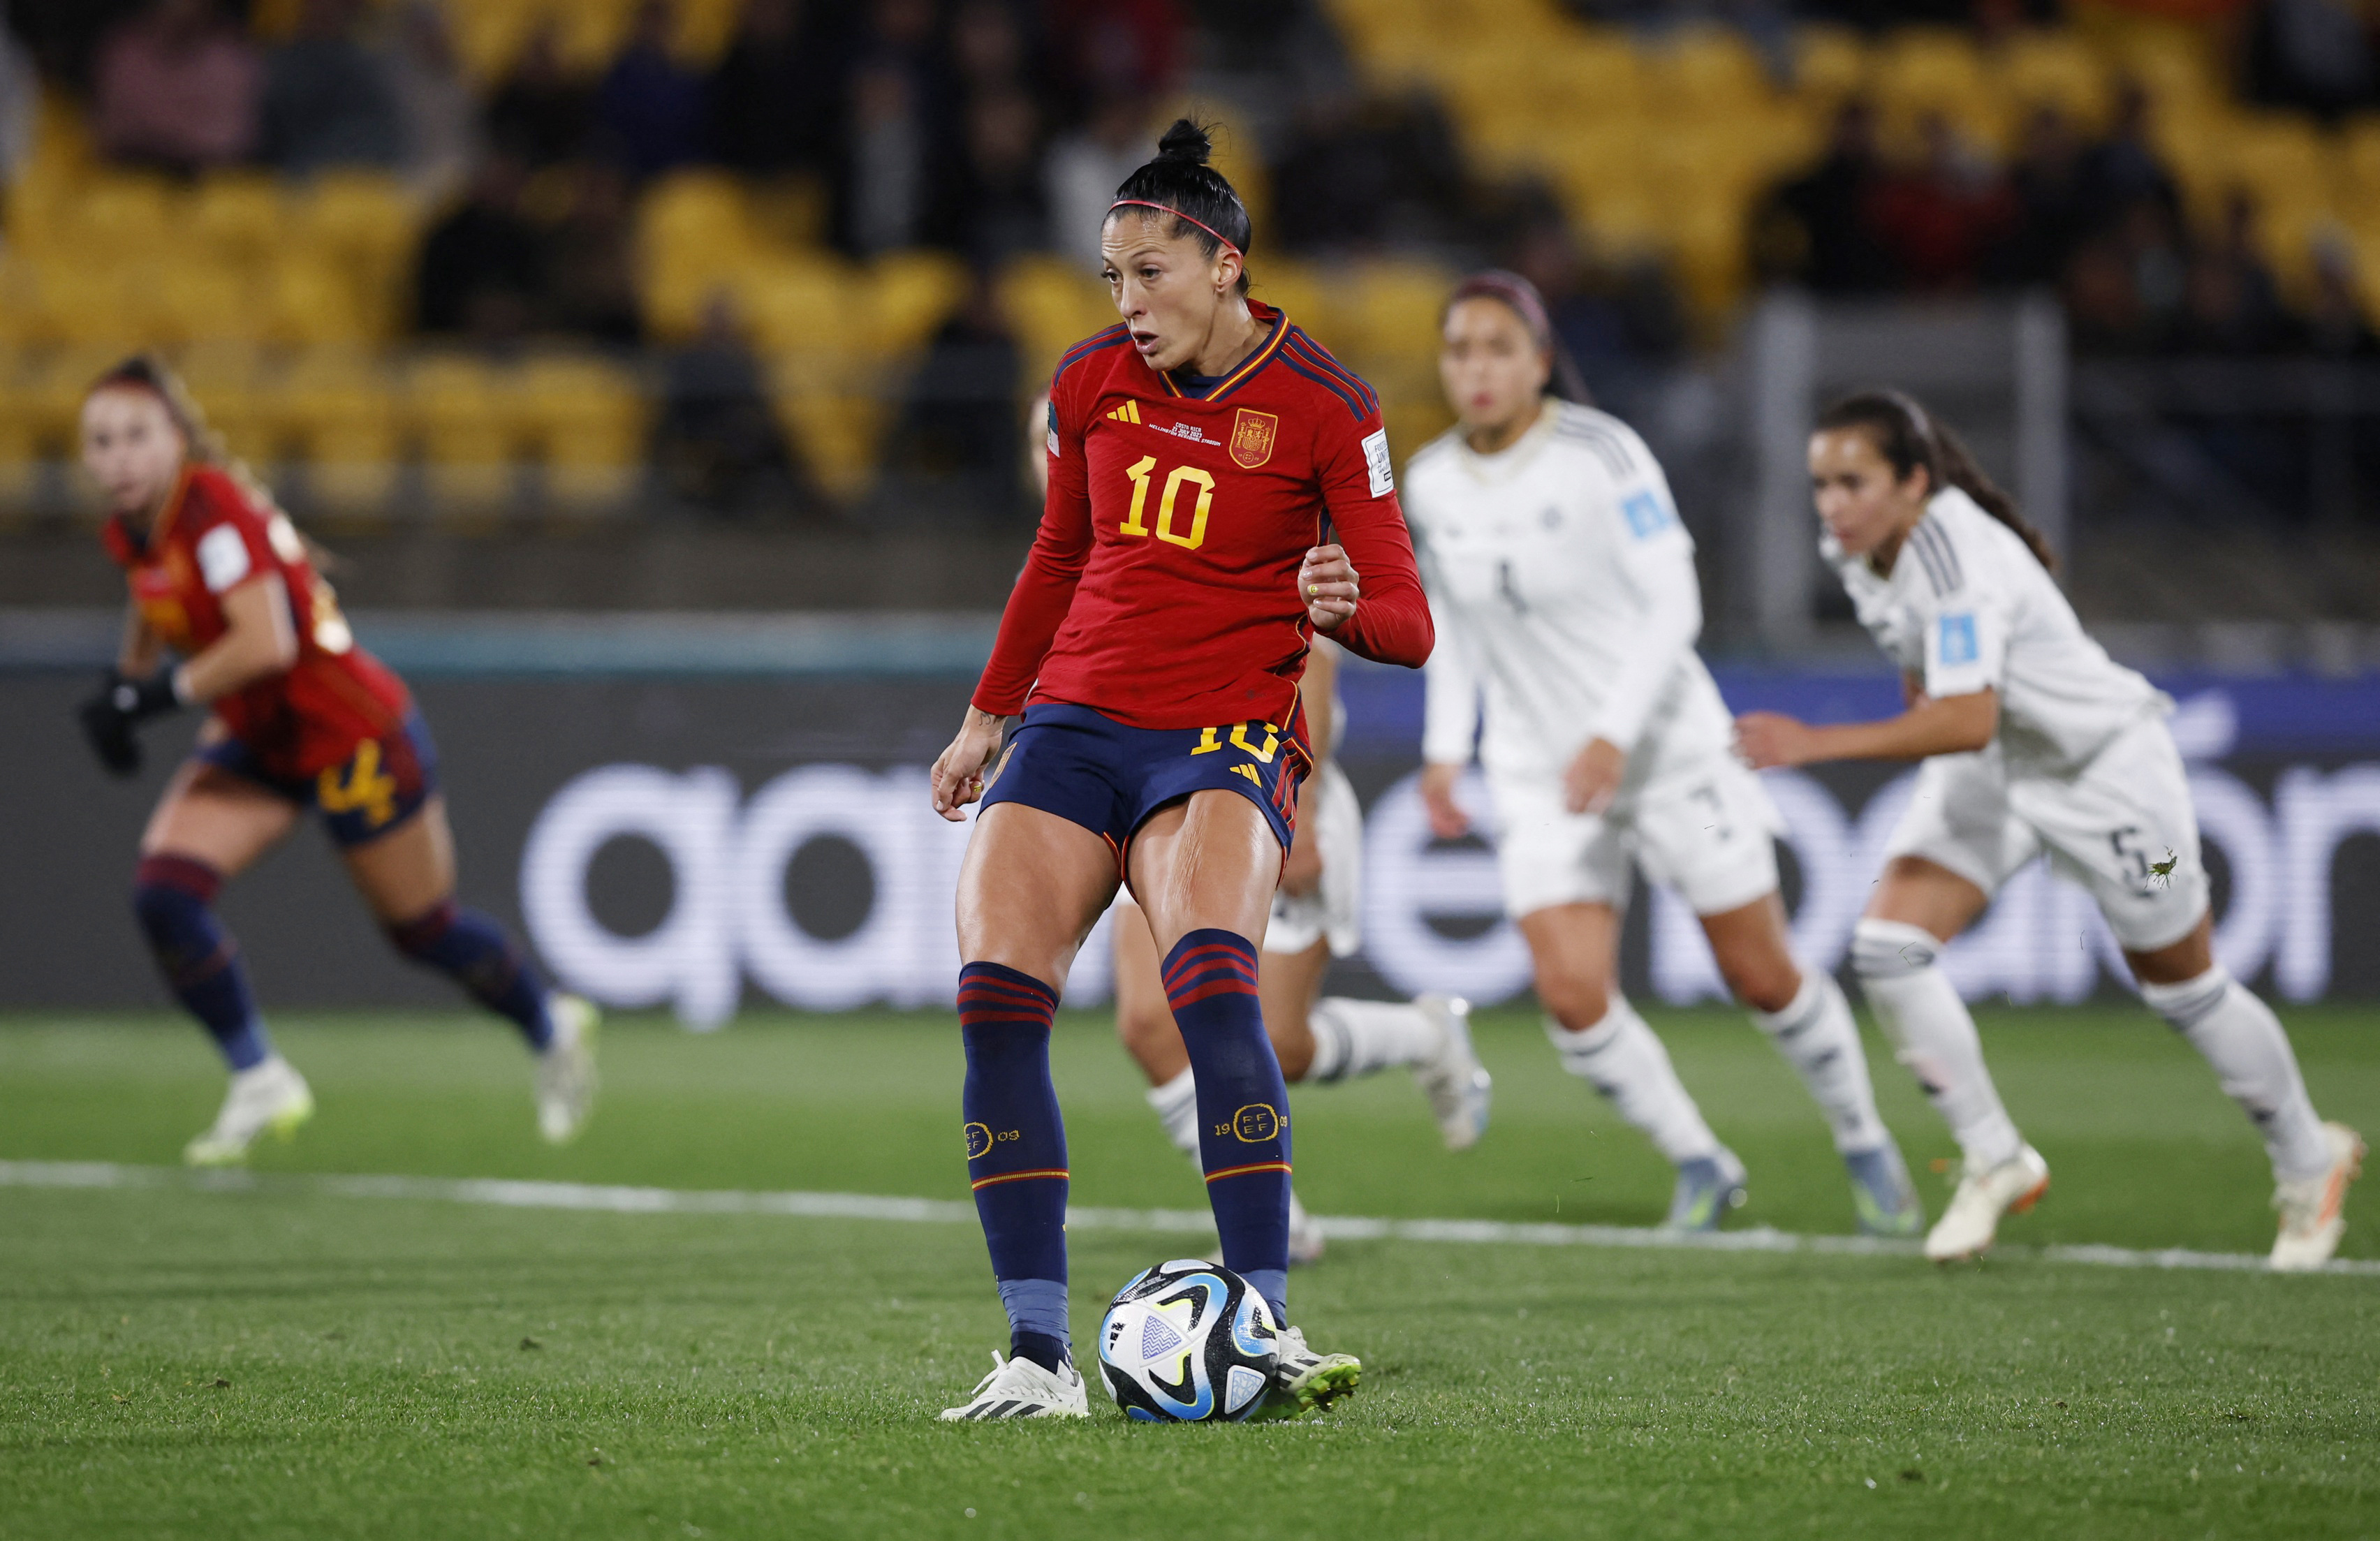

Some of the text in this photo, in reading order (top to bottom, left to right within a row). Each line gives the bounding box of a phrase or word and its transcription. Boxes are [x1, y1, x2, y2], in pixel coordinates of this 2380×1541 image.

[1175, 422, 1189, 430] COSTA
[1149, 423, 1221, 447] WELLINGTON REGIONAL STADIUM
[1119, 455, 1216, 550] 10
[997, 1130, 1020, 1142] 09
[1214, 1123, 1231, 1136] 19
